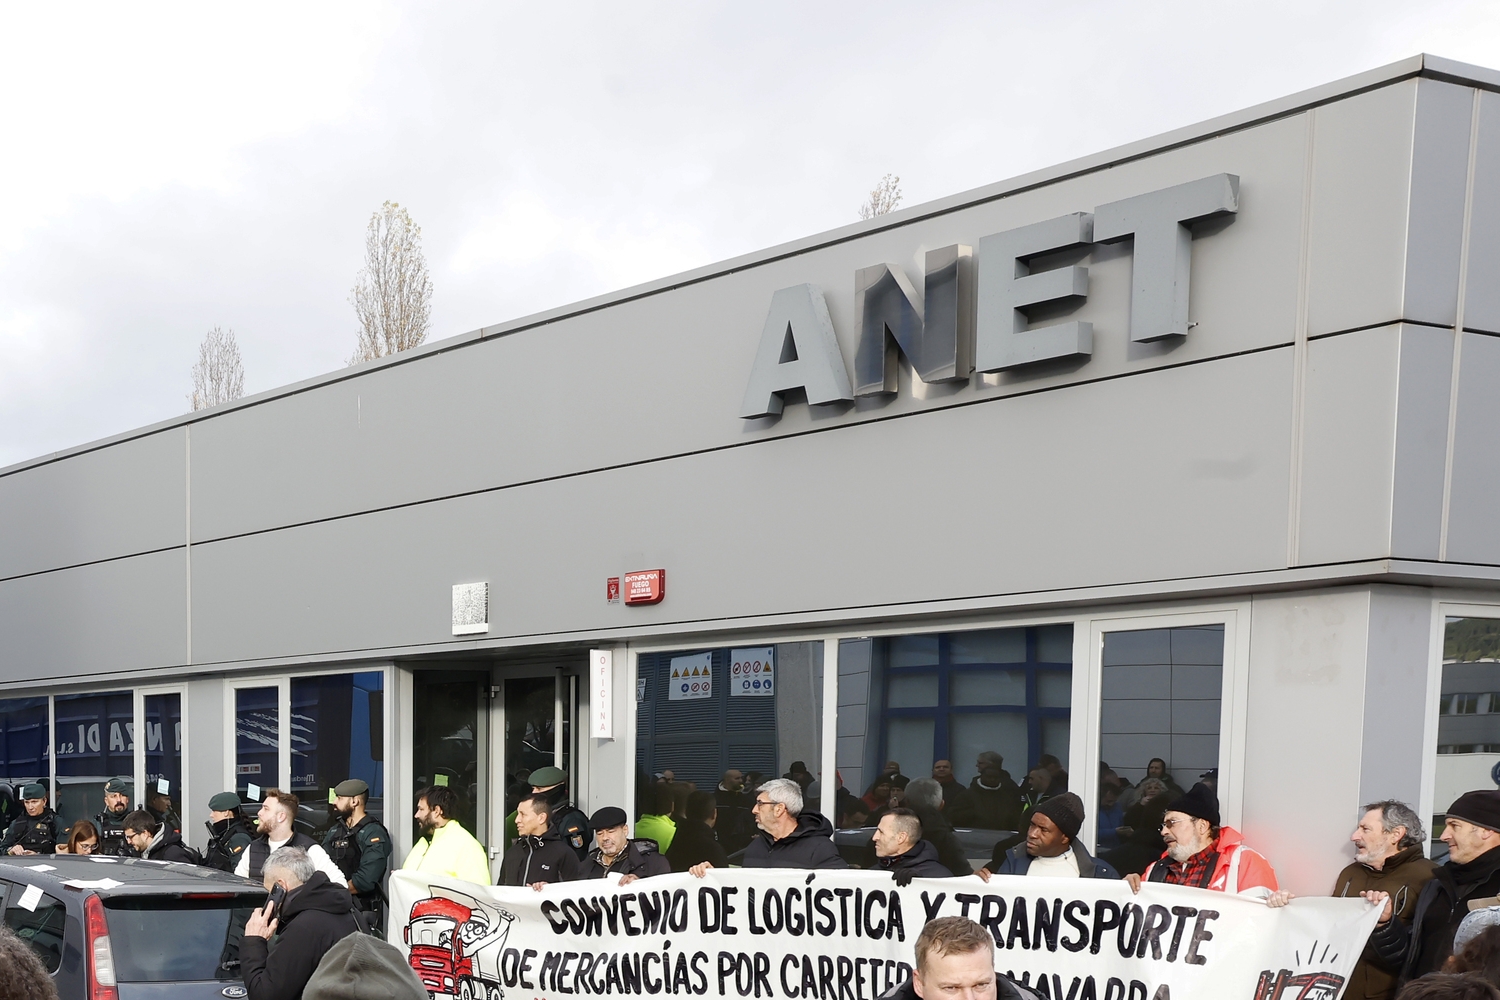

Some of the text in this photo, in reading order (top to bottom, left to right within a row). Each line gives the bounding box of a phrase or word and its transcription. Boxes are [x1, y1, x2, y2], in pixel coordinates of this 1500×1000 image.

[740, 172, 1240, 419] ANET
[541, 887, 687, 936] CONVENIO
[699, 886, 739, 936] DE
[748, 872, 905, 942] LOGÍSTICA
[955, 892, 1220, 965] TRANSPORTE
[501, 947, 534, 990] DE
[540, 940, 708, 995] MERCANCÍAS
[718, 951, 773, 998] POR
